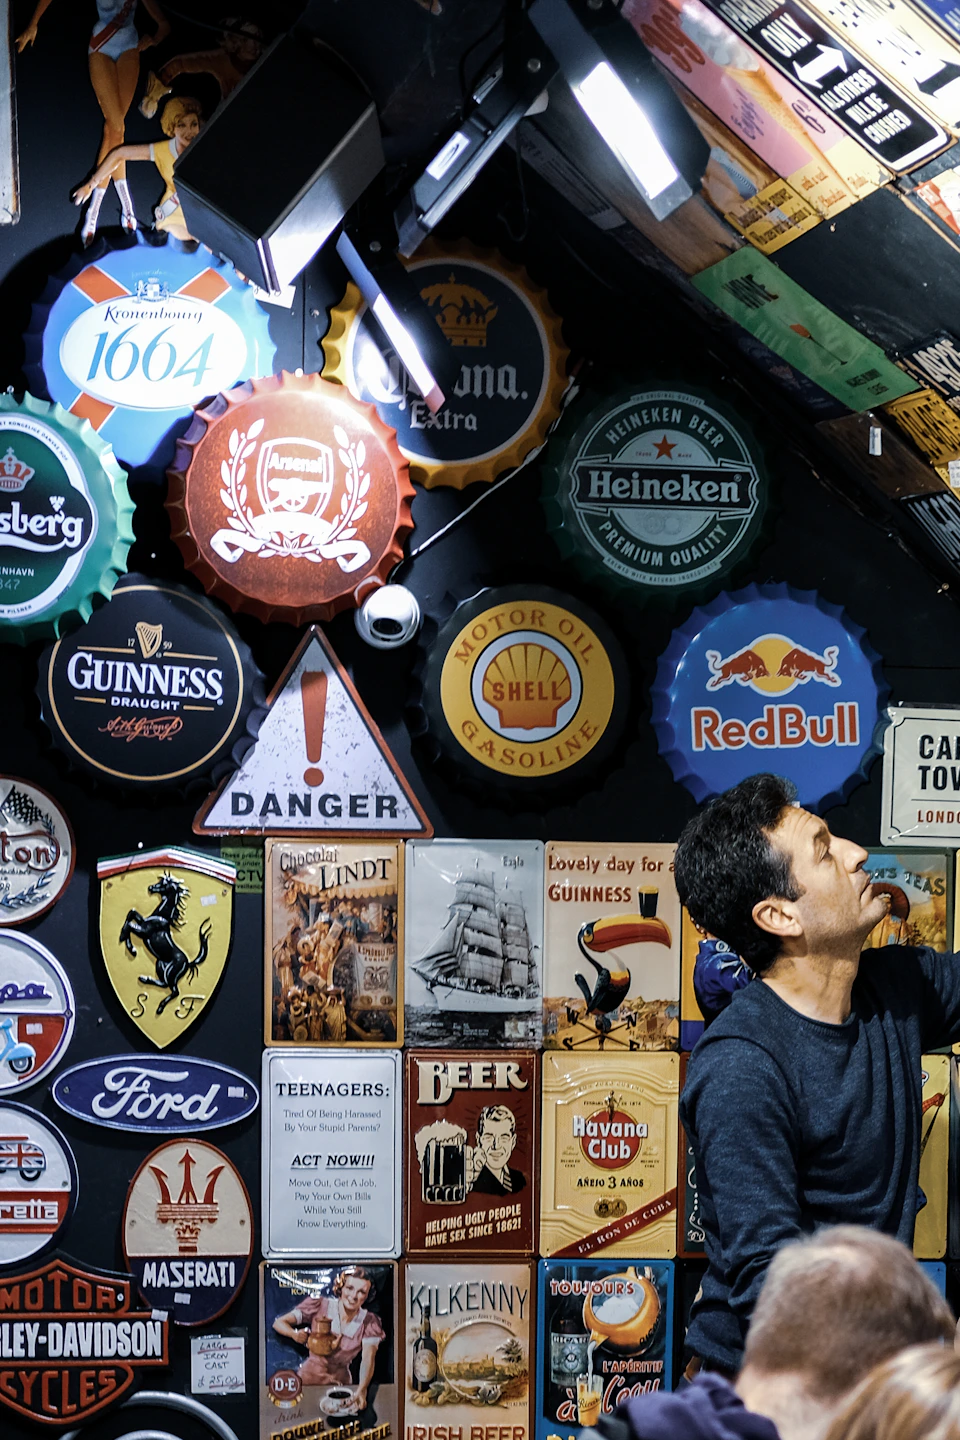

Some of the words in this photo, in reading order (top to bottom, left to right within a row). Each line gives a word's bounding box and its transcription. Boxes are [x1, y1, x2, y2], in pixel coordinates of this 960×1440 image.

[760, 12, 813, 58] ONLY
[843, 68, 877, 99] OTHERS
[863, 109, 912, 144] CRUSHED
[104, 306, 203, 324] Kronenbourg
[86, 323, 215, 387] 1664
[410, 400, 478, 430] Extra
[605, 407, 683, 446] HEINEKEN
[688, 414, 725, 448] BEER
[268, 451, 324, 474] Arsenal
[588, 470, 741, 503] Heineken
[599, 521, 663, 567] PREMIUM
[669, 524, 727, 567] QUALITY
[127, 638, 136, 648] 17
[163, 641, 173, 649] 59
[454, 609, 546, 666] MOTOR
[558, 618, 594, 664] OIL
[67, 651, 223, 700] GUINNESS
[111, 696, 180, 711] DRAUGHT
[493, 681, 562, 702] SHELL
[461, 719, 599, 769] GASOLINE
[231, 792, 399, 819] DANGER
[279, 848, 338, 871] Chocolat
[548, 855, 600, 874] Lovely
[606, 856, 635, 874] day
[641, 856, 663, 872] for
[318, 858, 392, 891] LINDT
[904, 869, 945, 896] TEAS
[548, 884, 631, 903] GUINNESS
[131, 993, 148, 1018] S
[175, 994, 205, 1019] F
[91, 1066, 220, 1123] Ford
[276, 1083, 390, 1097] TEENAGERS:
[416, 1061, 528, 1105] BEER
[283, 1109, 304, 1118] Tired
[319, 1110, 342, 1120] Being
[344, 1110, 381, 1118] Harassed
[573, 1115, 648, 1138] Havana
[319, 1123, 345, 1134] Stupid
[291, 1155, 322, 1166] ACT
[326, 1155, 375, 1166] NOW!!!
[588, 1139, 631, 1159] Club
[607, 1176, 617, 1190] 3
[620, 1176, 644, 1188] AÑOS
[304, 1206, 326, 1215] While
[426, 1214, 462, 1234] HELPING
[465, 1210, 486, 1226] UGLY
[489, 1203, 521, 1222] PEOPLE
[643, 1200, 672, 1220] CUBA
[425, 1232, 448, 1247] HAVE
[450, 1229, 466, 1243] SEX
[469, 1225, 493, 1239] SINCE
[496, 1216, 521, 1234] 1862!
[143, 1261, 236, 1288] MASERATI
[0, 1270, 117, 1311] MOTOR
[409, 1281, 529, 1320] KILKENNY
[550, 1280, 635, 1296] TOUJOURS
[200, 1342, 227, 1350] LARGE
[203, 1352, 229, 1361] IRON
[205, 1361, 229, 1370] CAST
[0, 1370, 117, 1415] CYCLES
